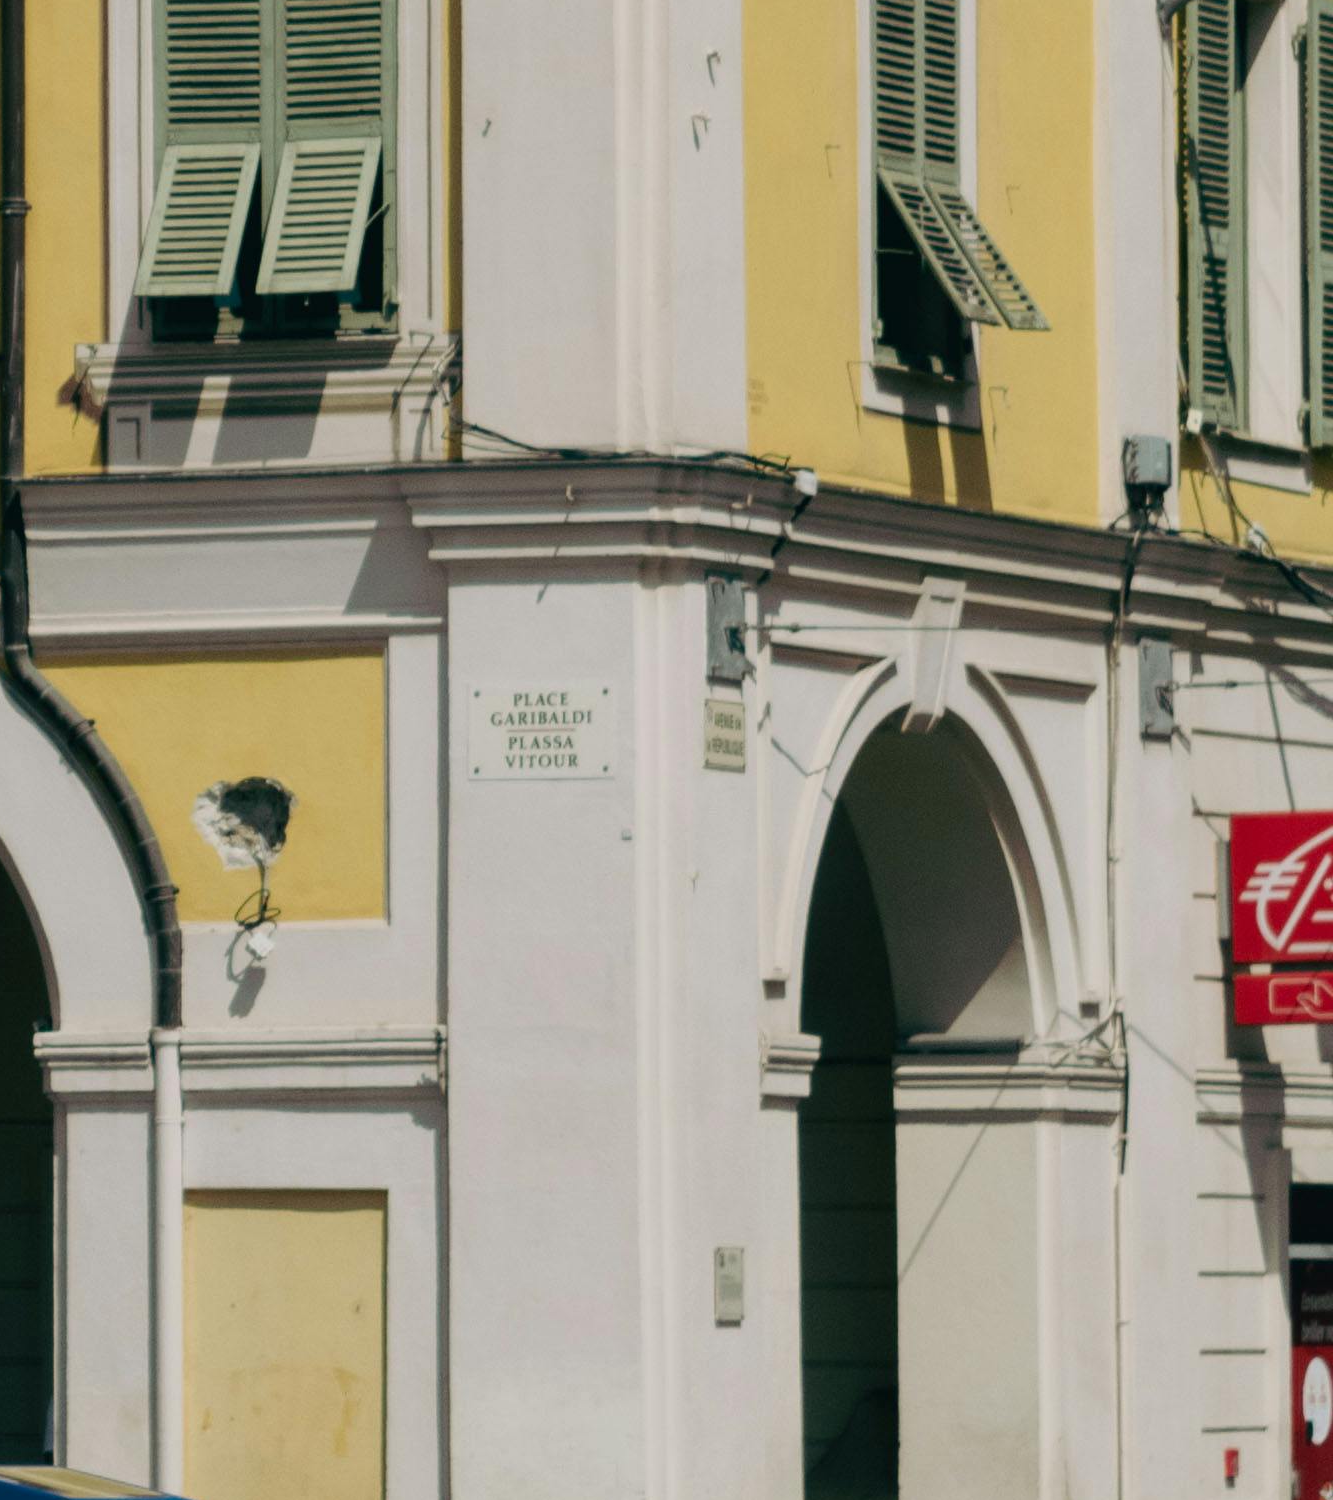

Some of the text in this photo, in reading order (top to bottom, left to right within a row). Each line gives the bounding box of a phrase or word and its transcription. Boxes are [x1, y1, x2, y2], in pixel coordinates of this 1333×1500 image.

[513, 692, 569, 707] PLACE
[490, 710, 592, 727] GARIBALDI
[508, 735, 574, 750] PLASSA
[505, 754, 578, 769] VITOUR
